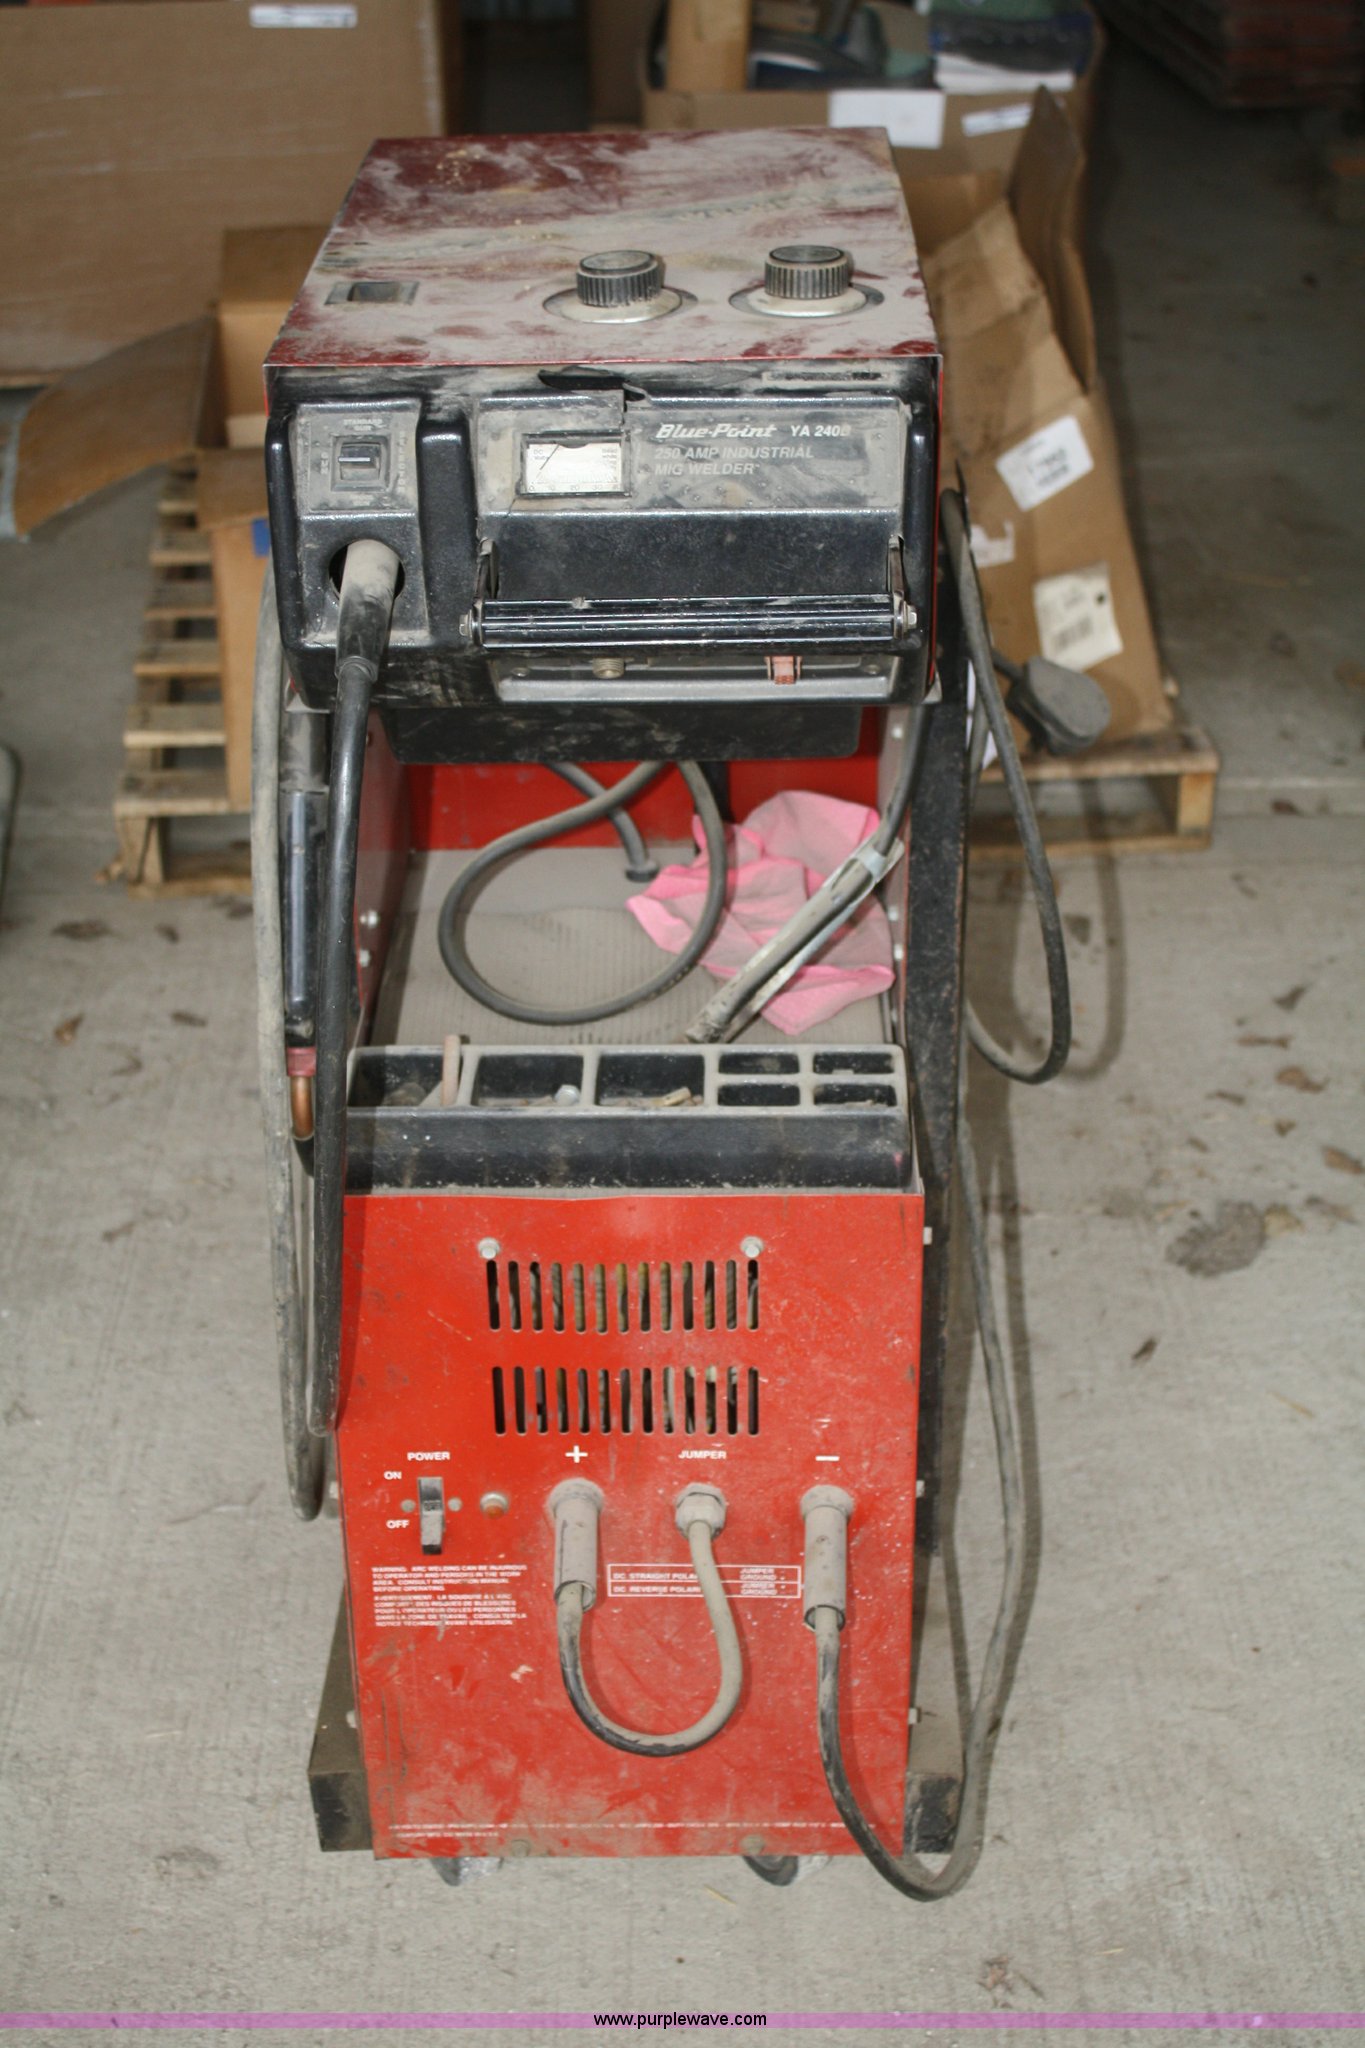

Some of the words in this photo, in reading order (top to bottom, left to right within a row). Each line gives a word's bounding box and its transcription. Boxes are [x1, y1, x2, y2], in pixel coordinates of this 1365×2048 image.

[791, 425, 810, 437] YA
[655, 447, 680, 460] 250
[685, 446, 719, 460] AMP
[722, 446, 814, 459] INDUSTRIAL
[655, 463, 682, 476] MIG
[407, 1451, 451, 1462] POWER
[678, 1450, 727, 1460] JUMPER
[383, 1470, 402, 1480] ON
[386, 1519, 410, 1529] OFF
